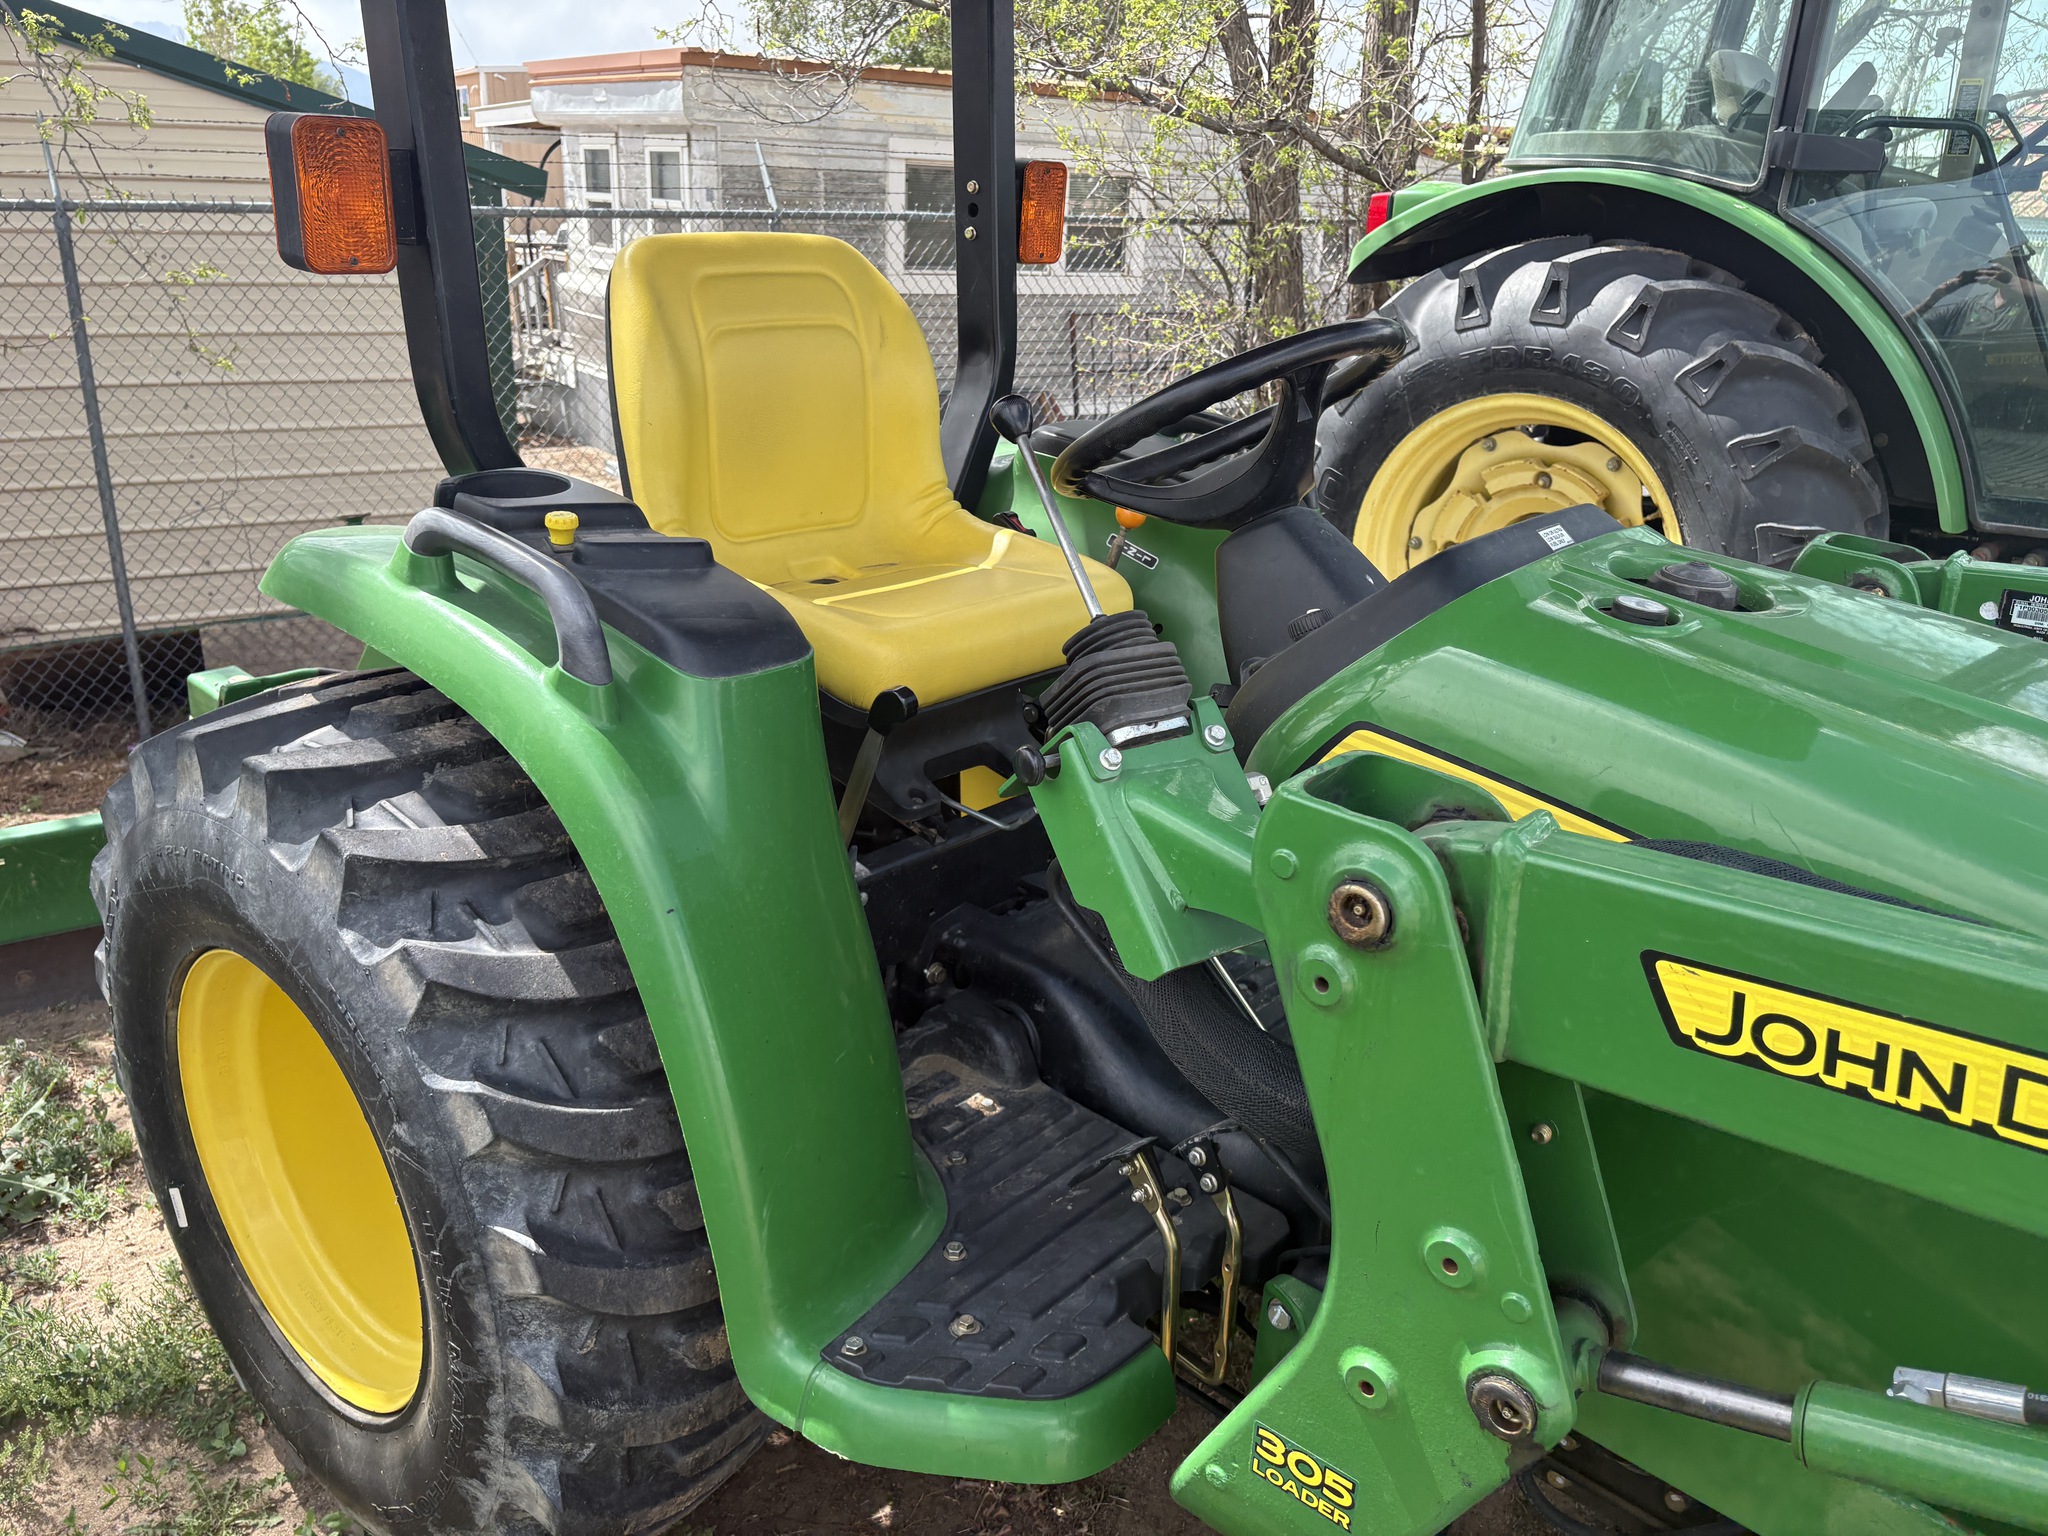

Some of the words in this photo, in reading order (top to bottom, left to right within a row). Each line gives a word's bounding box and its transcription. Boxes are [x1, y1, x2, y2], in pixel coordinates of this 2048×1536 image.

[2029, 595, 2048, 604] JOH
[164, 845, 188, 858] PLY
[1694, 991, 1968, 1114] JOHN
[1252, 1457, 1352, 1532] LOADER
[1255, 1426, 1355, 1509] 305
